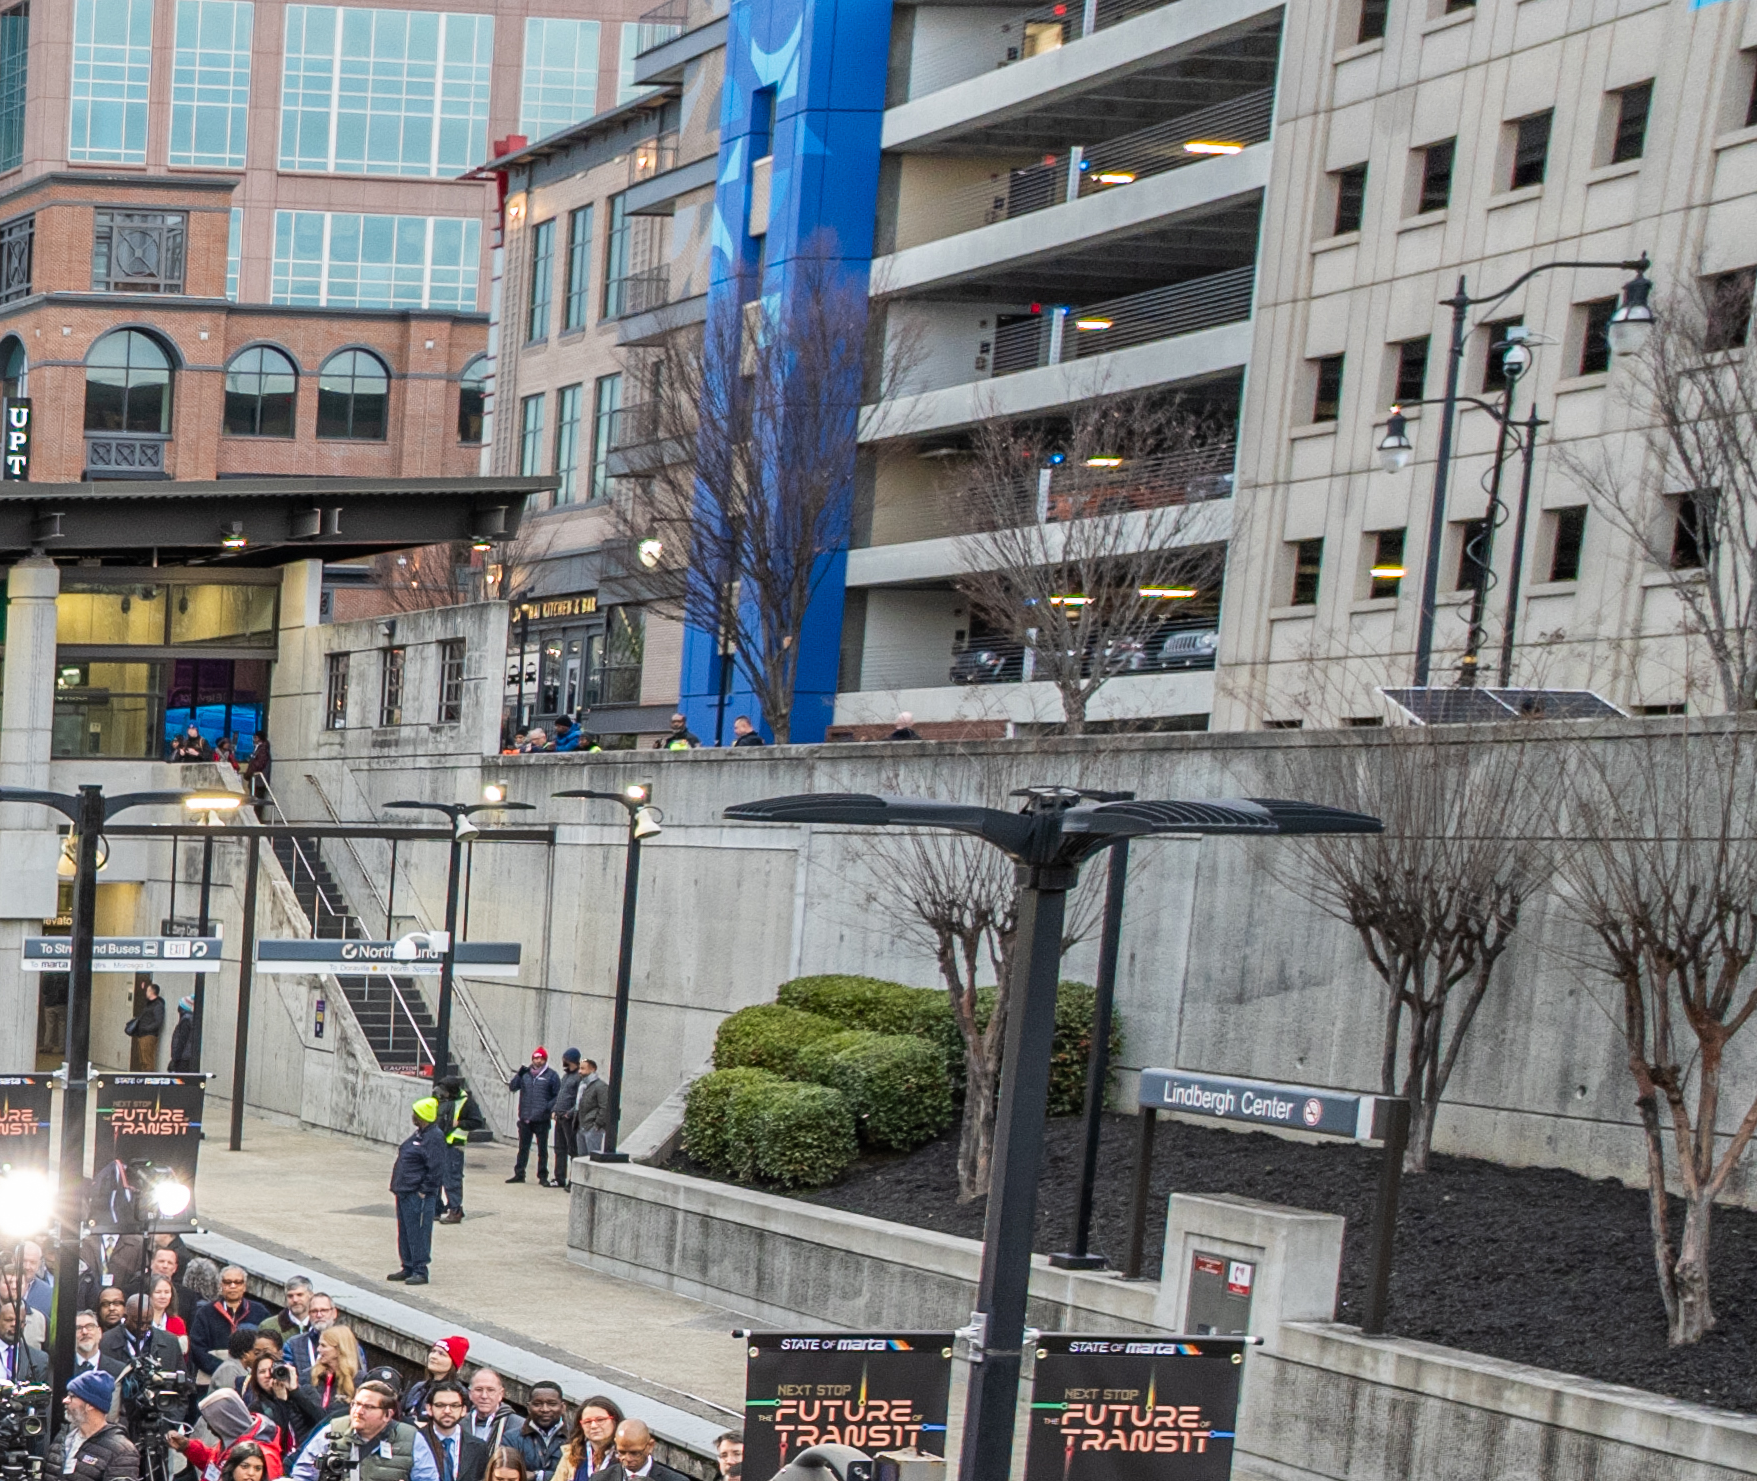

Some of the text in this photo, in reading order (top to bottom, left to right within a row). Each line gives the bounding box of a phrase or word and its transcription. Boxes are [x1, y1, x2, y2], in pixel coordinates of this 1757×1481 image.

[7, 408, 29, 482] UPT
[542, 600, 572, 618] KITCHEN
[581, 596, 597, 614] BAR
[43, 916, 72, 926] levato
[40, 943, 53, 954] To
[93, 943, 106, 954] nd
[108, 943, 141, 954] Buses
[358, 944, 438, 959] Northund
[114, 1077, 136, 1085] STATE
[144, 1077, 171, 1085] marta
[1163, 1080, 1295, 1120] Lindbergh Center
[111, 1108, 185, 1122] FUTURE
[111, 1121, 190, 1136] TRANSIT
[781, 1338, 886, 1350] STATE OF marta
[1069, 1341, 1176, 1355] STATE OF marta
[777, 1384, 852, 1396] NEXT STOP
[1064, 1388, 1140, 1400] NEXT STOP
[775, 1400, 913, 1422] FUTURE
[1044, 1404, 1212, 1428] THE FUTURE OF
[774, 1425, 923, 1447] TRANSIT
[1060, 1429, 1211, 1453] TRANSIT
